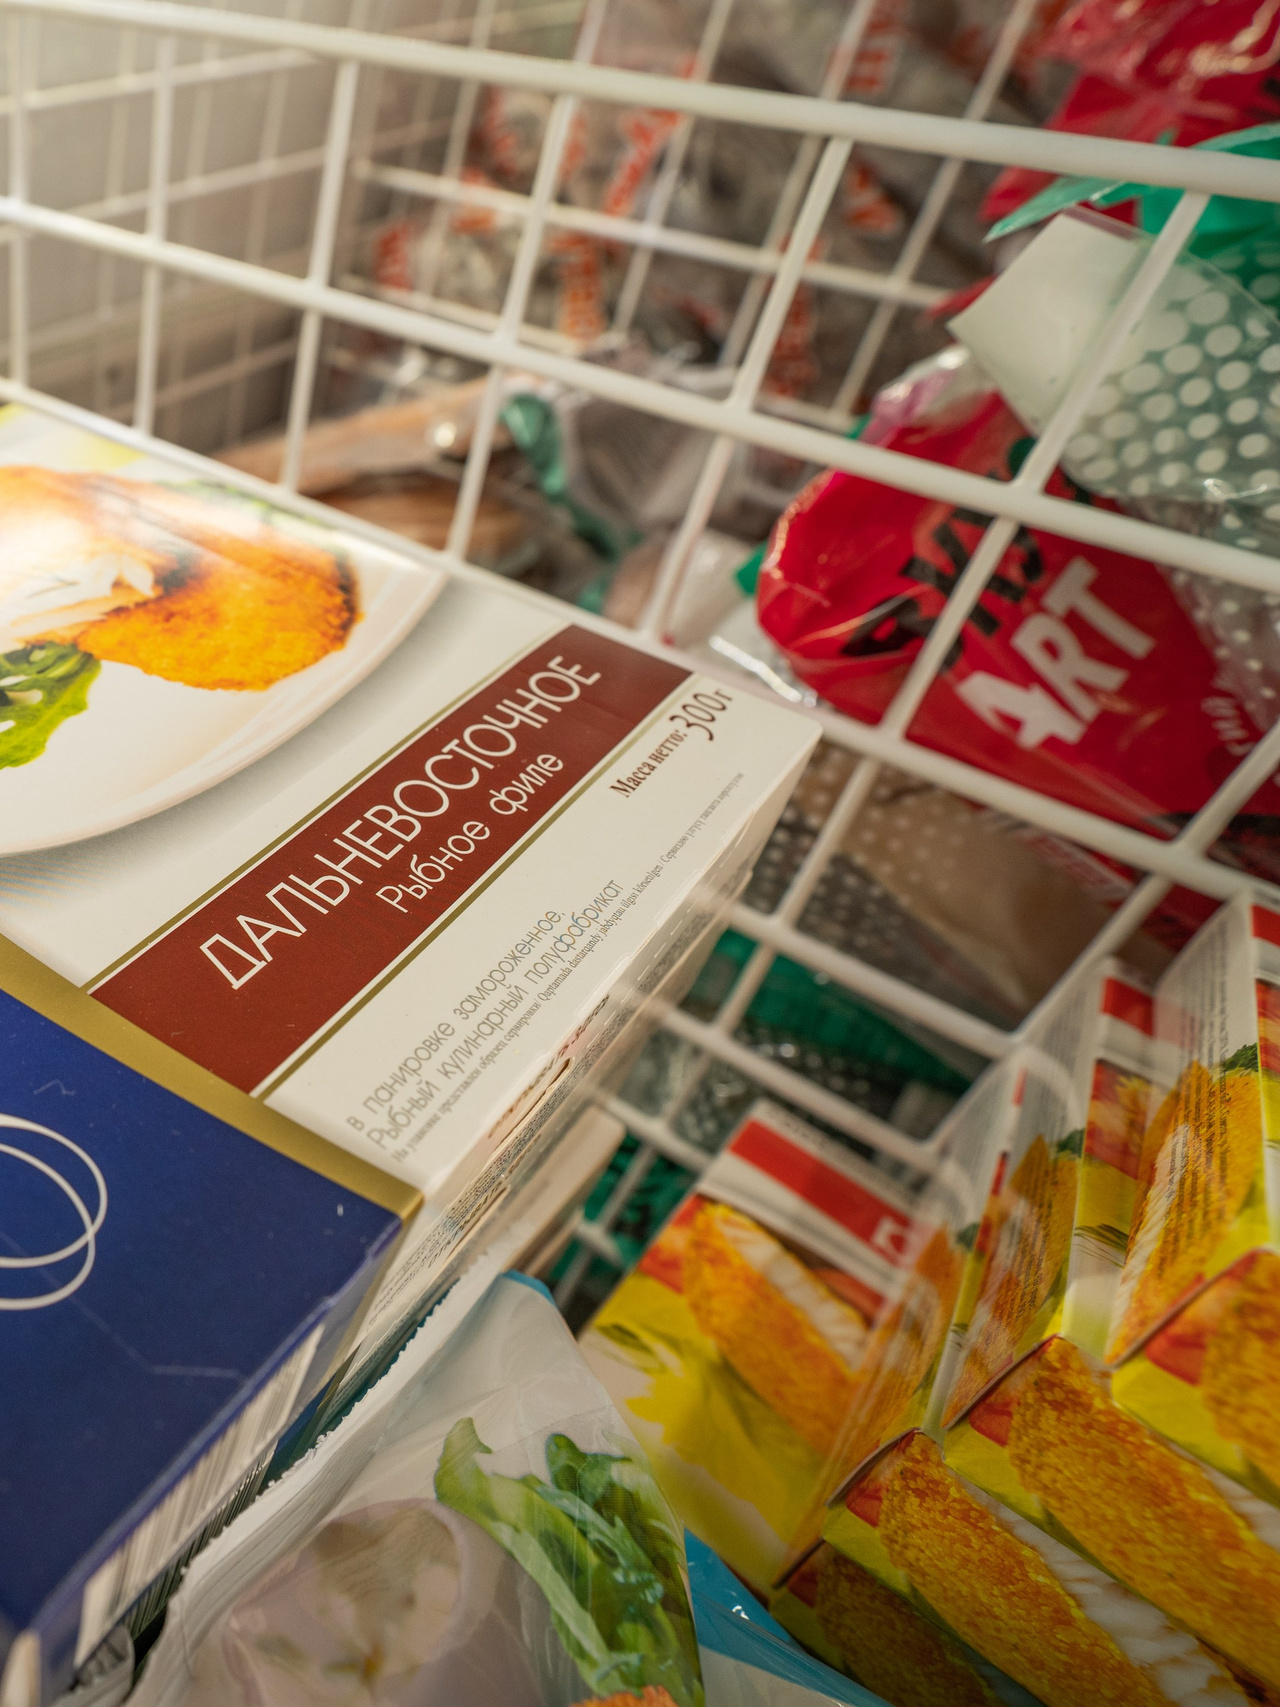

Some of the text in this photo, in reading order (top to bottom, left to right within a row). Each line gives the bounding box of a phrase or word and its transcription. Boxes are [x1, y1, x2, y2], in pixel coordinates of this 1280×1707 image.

[199, 655, 601, 990] ДАЛЬНЕВОСТОЧНОЕ
[375, 752, 565, 914] Рыбное филе
[609, 688, 734, 799] Масса нетто: 300г
[363, 1022, 456, 1116] панировке
[453, 911, 566, 1020] замороженное,
[366, 1079, 441, 1151] Рыбный
[436, 984, 530, 1080] кулинарный
[524, 879, 624, 985] полуфабрикат
